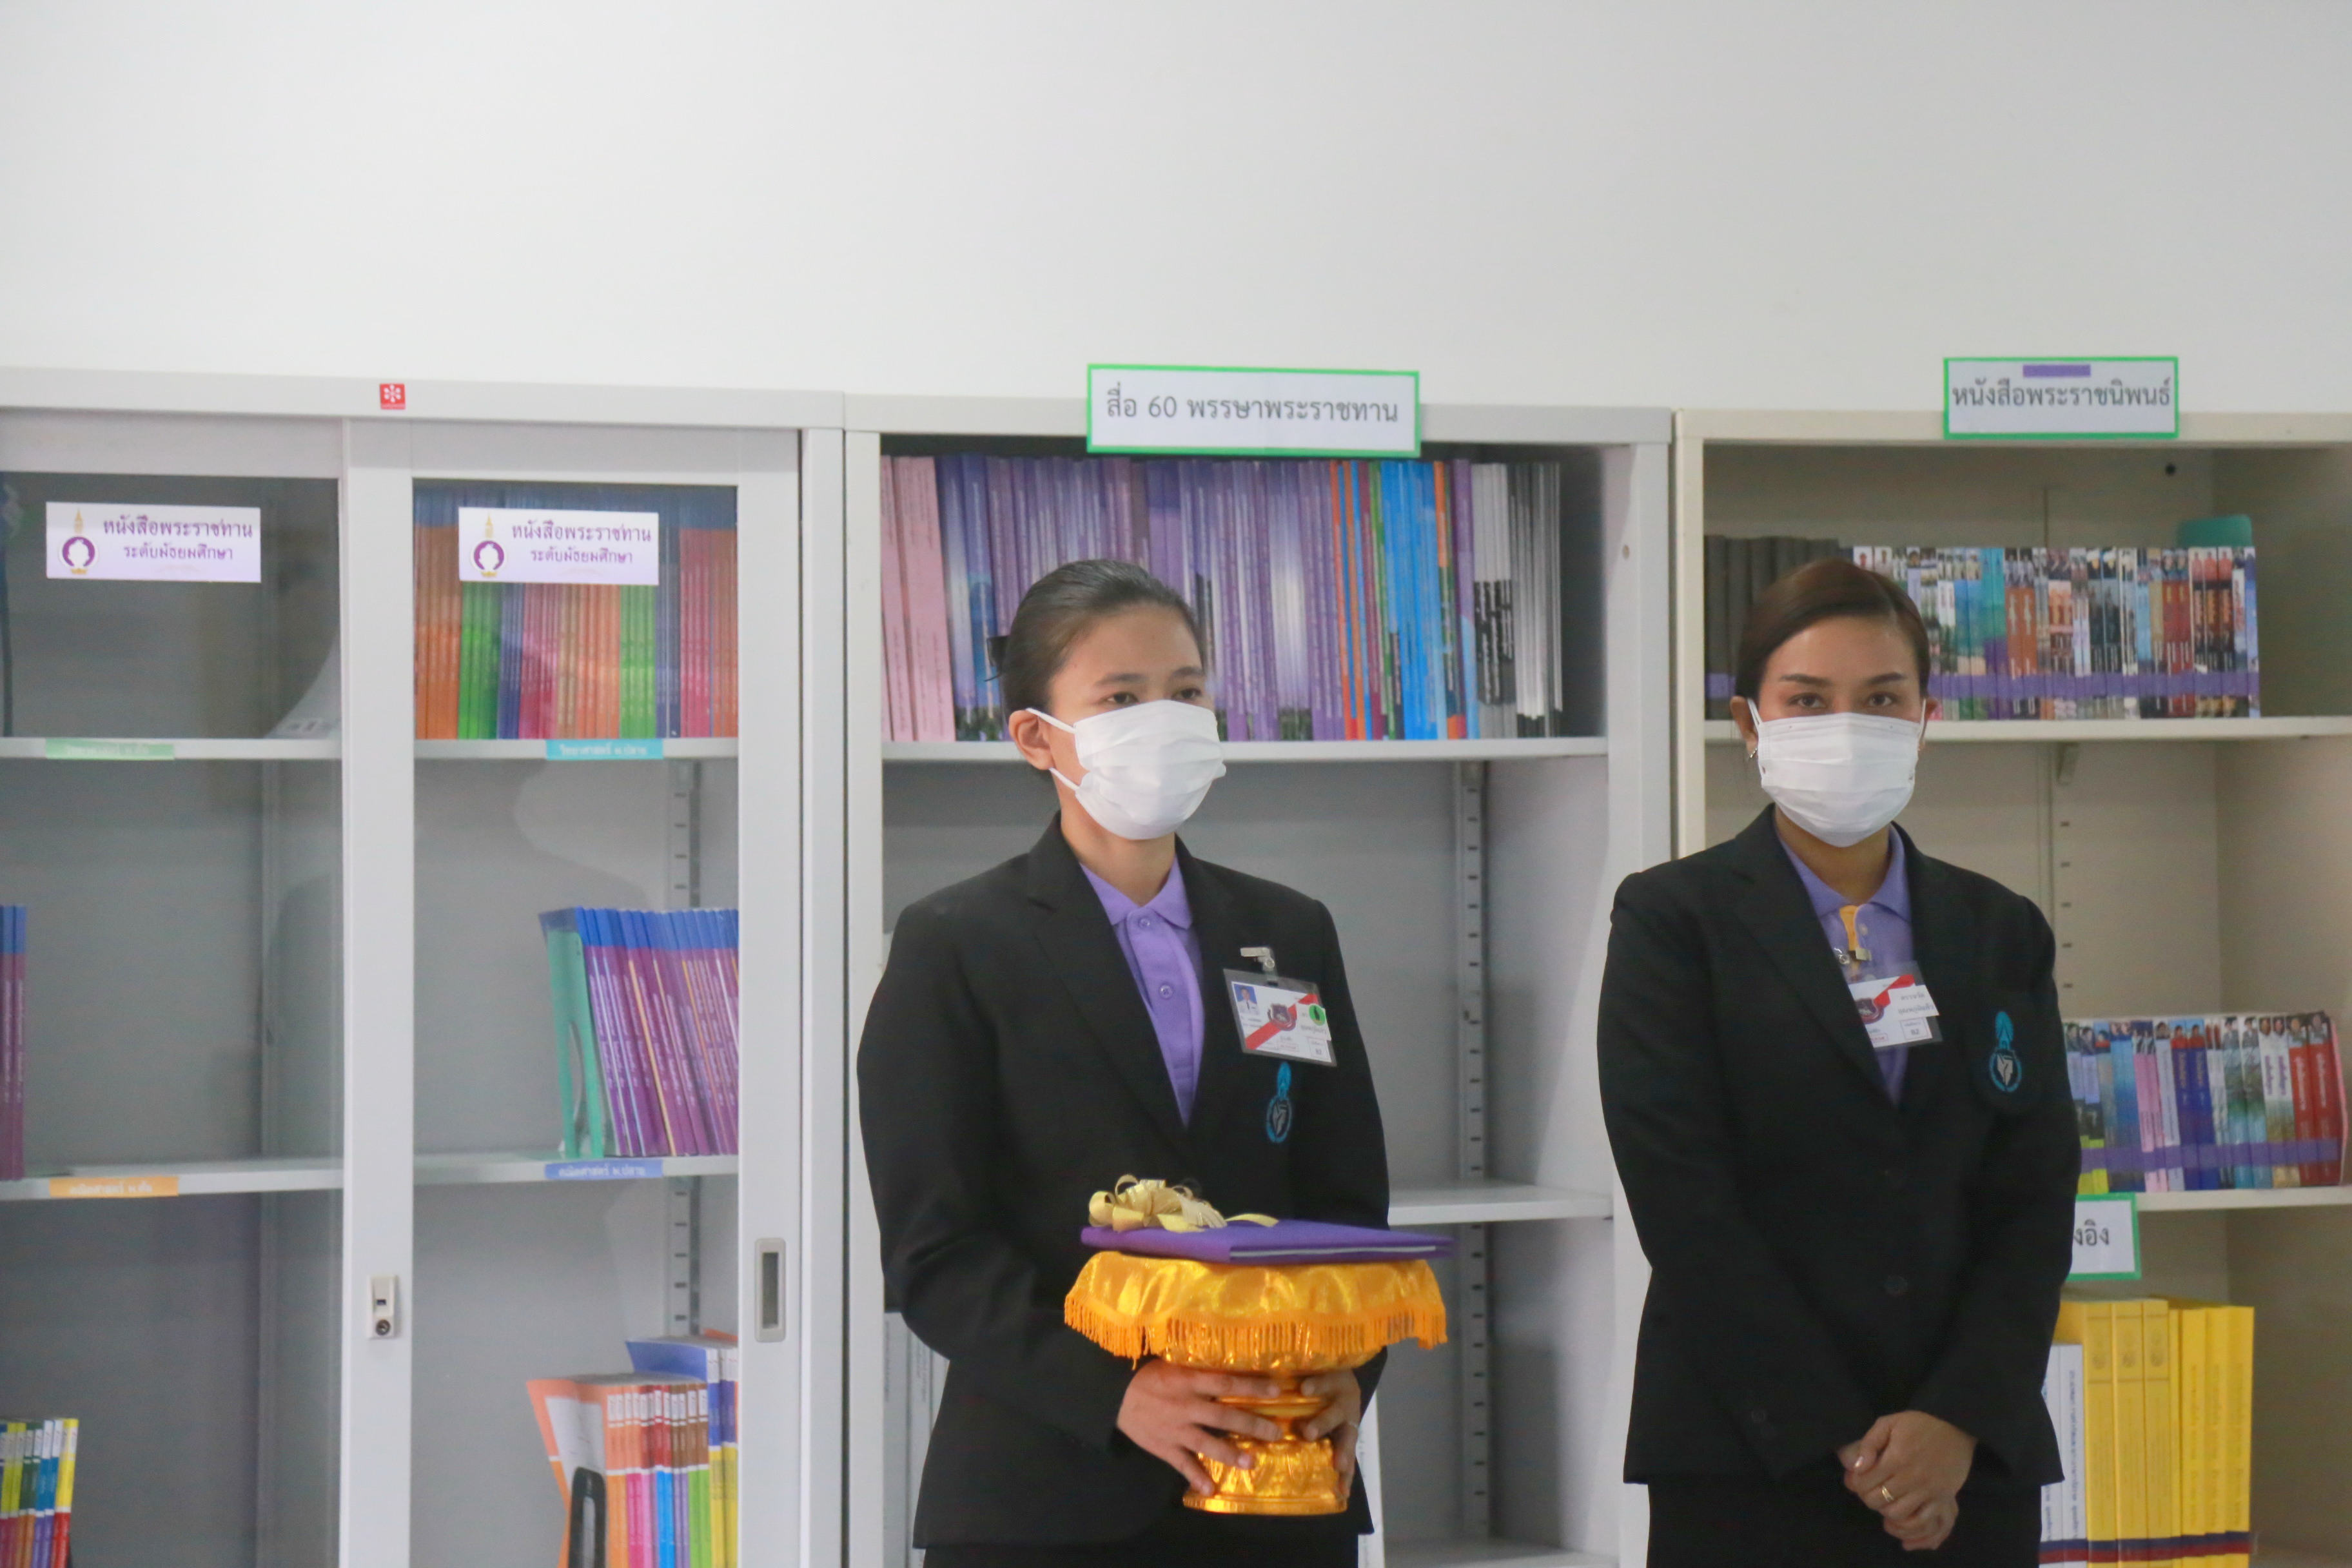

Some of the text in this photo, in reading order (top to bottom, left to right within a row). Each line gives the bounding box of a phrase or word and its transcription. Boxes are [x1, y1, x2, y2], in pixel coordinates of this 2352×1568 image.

[1106, 382, 1398, 422] สื่อ 60 พรรษาพระราชทาน
[1952, 377, 2171, 407] หนังสือพระราชนิพนธ์
[103, 514, 253, 538] หนังสือพระราชทาน
[512, 518, 651, 542] หนังสือพระราชทาน
[124, 542, 233, 560] ระดับมัธยมศึกษา
[531, 546, 633, 564] ระดับมัธยมศึกษา
